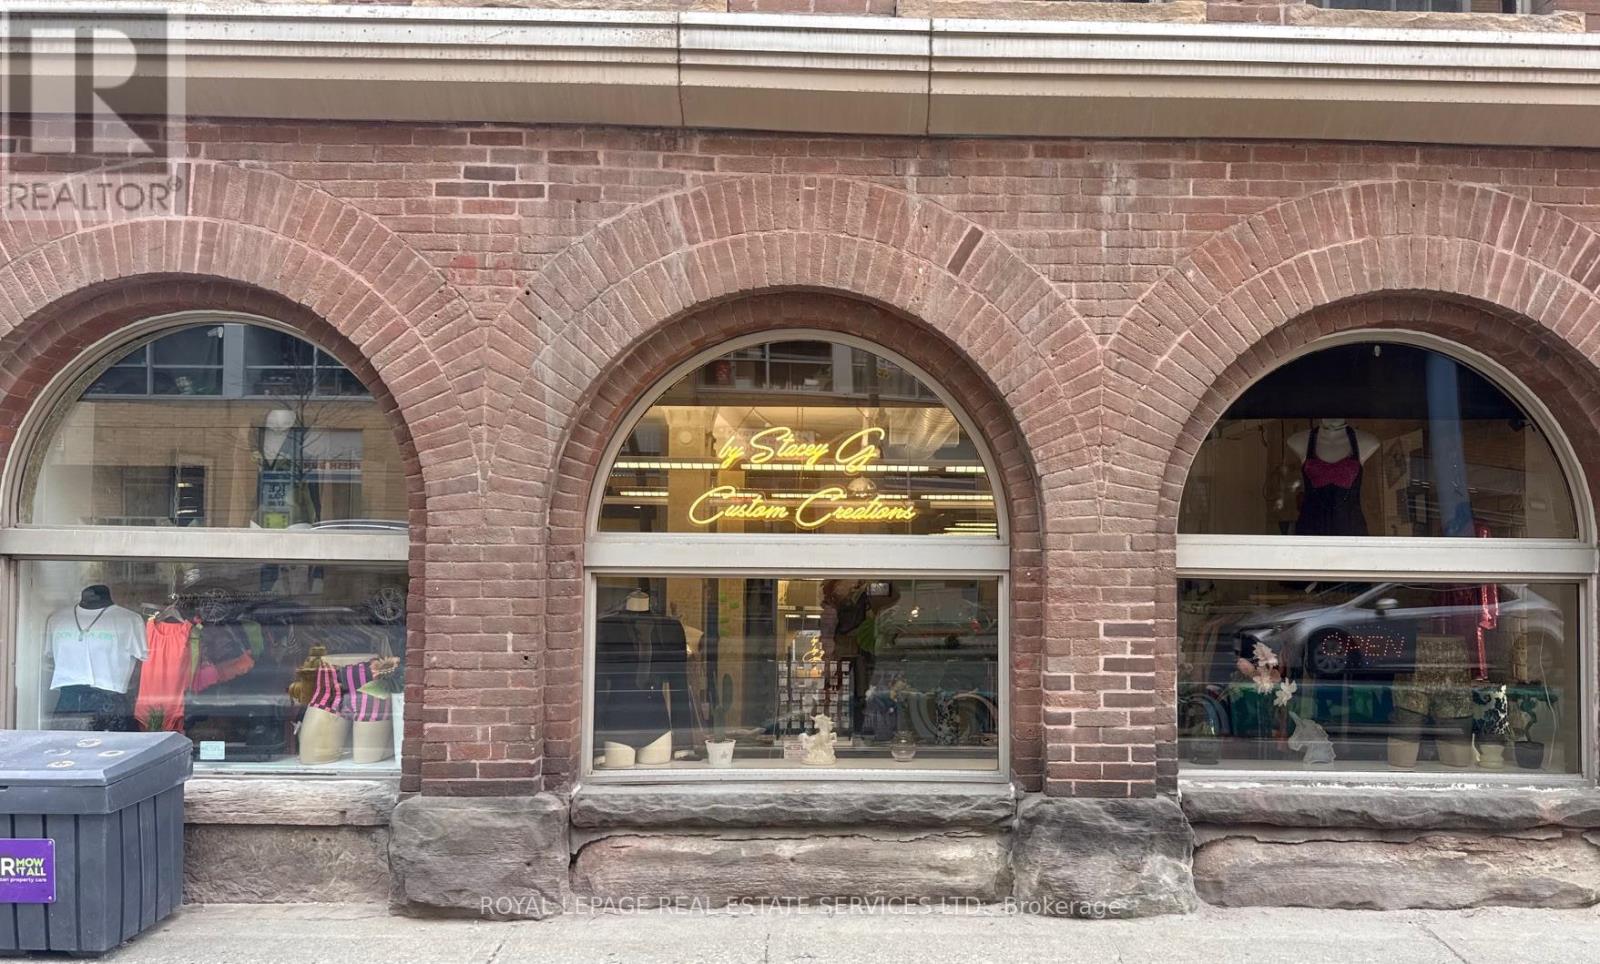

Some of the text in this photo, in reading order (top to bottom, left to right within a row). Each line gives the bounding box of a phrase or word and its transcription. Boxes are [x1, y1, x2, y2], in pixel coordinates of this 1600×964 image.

[719, 436, 744, 469] by
[750, 426, 829, 465] Stacey
[689, 485, 916, 527] Custom Creations
[1322, 632, 1405, 657] OPEN
[16, 858, 44, 867] MOW
[27, 867, 46, 876] ALL
